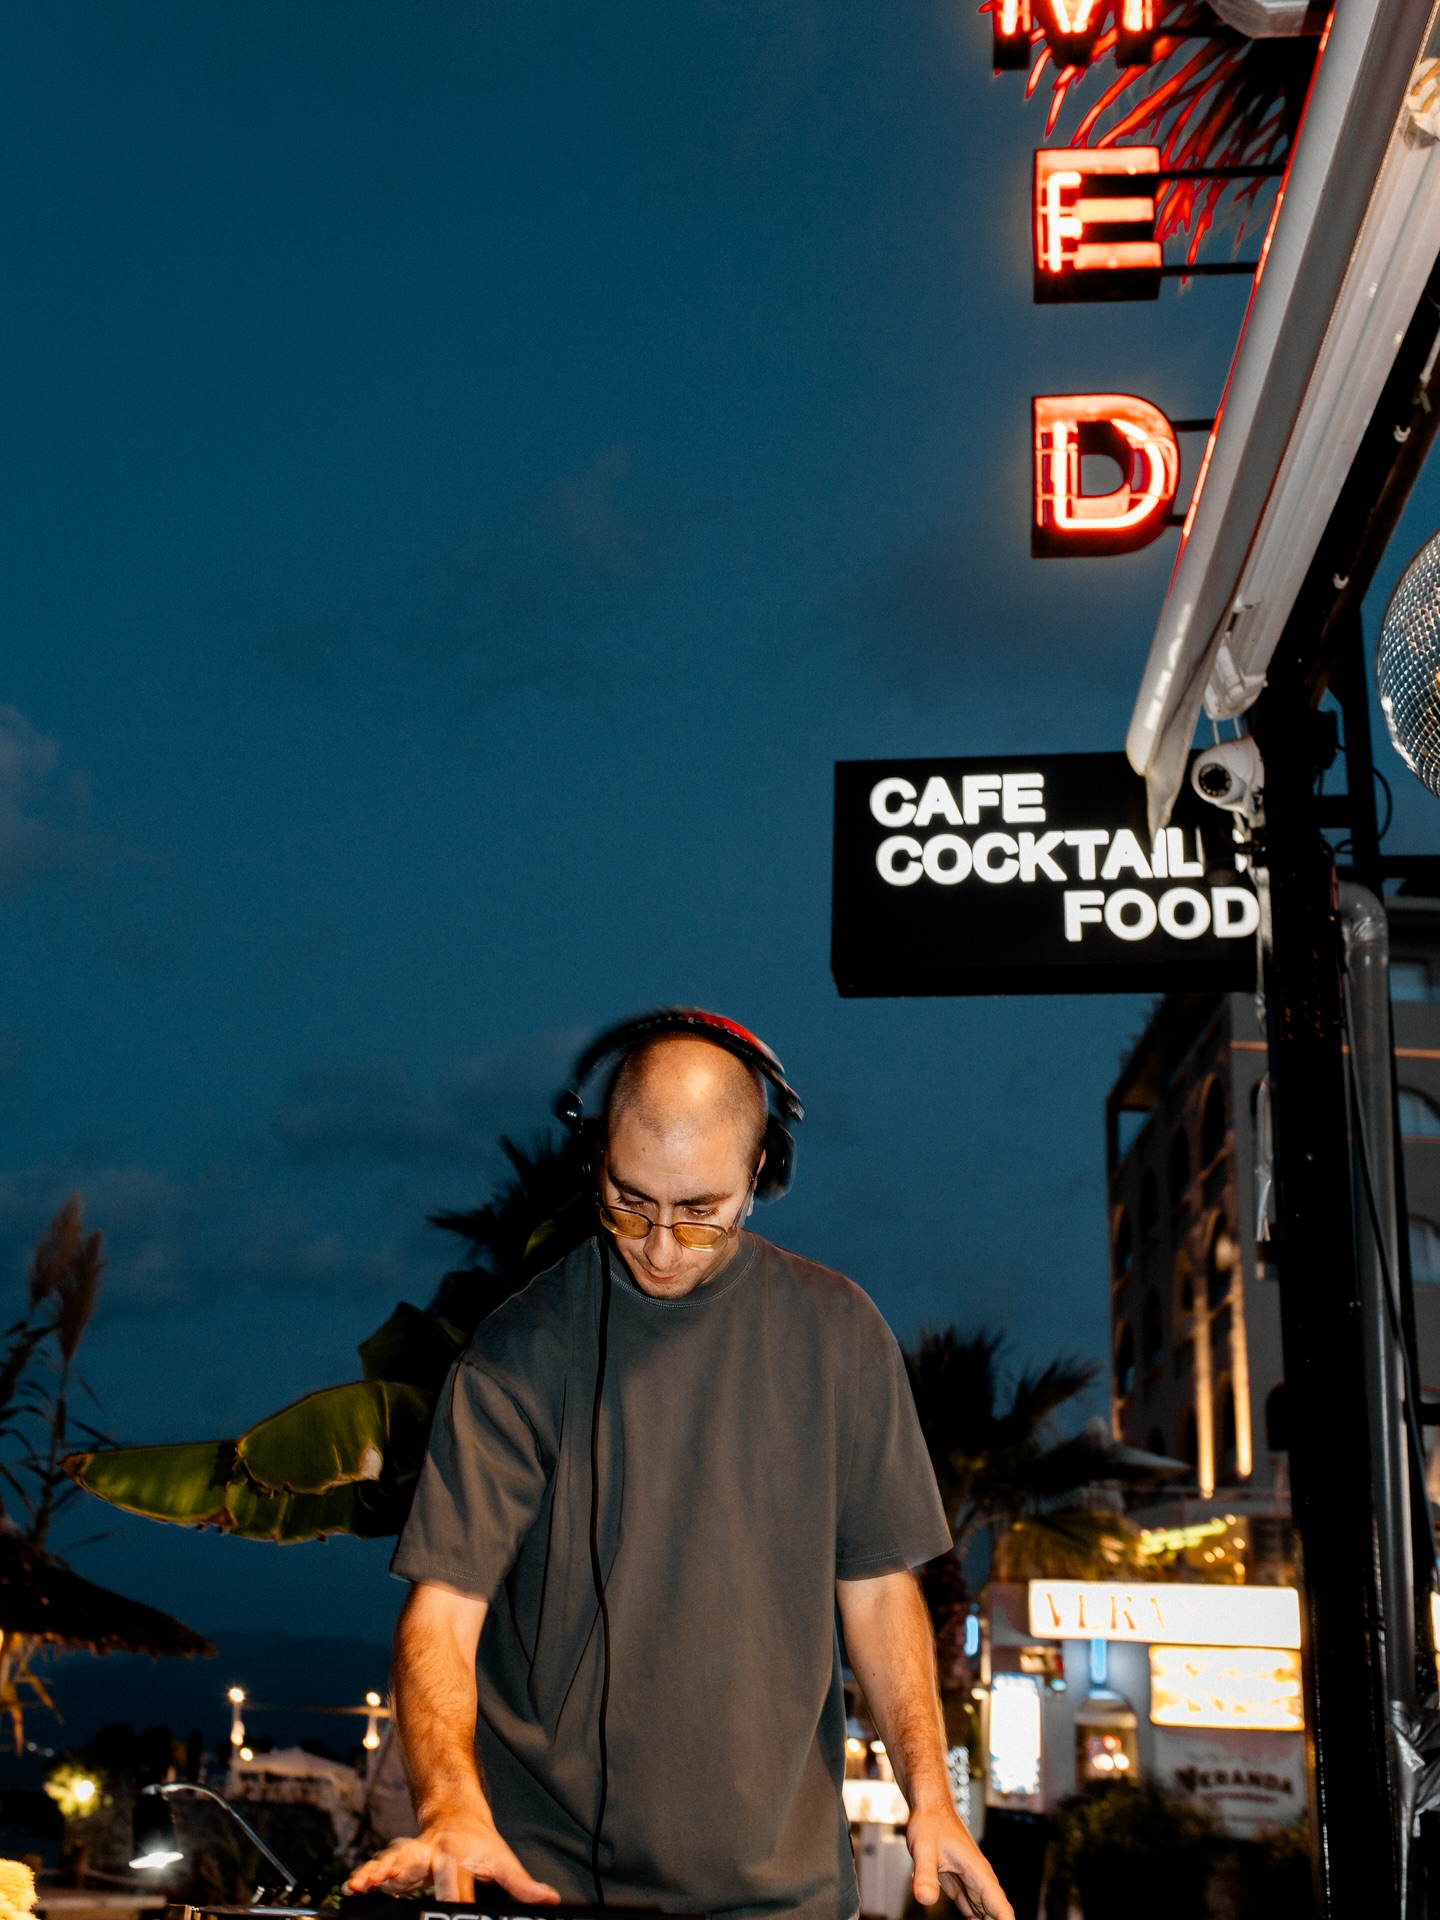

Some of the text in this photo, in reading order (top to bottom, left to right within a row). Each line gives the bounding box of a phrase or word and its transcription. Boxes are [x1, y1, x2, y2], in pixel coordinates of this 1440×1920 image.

[869, 772, 1047, 828] CAFE
[875, 827, 1205, 887] COCKTAIL
[1064, 886, 1261, 943] FOOD
